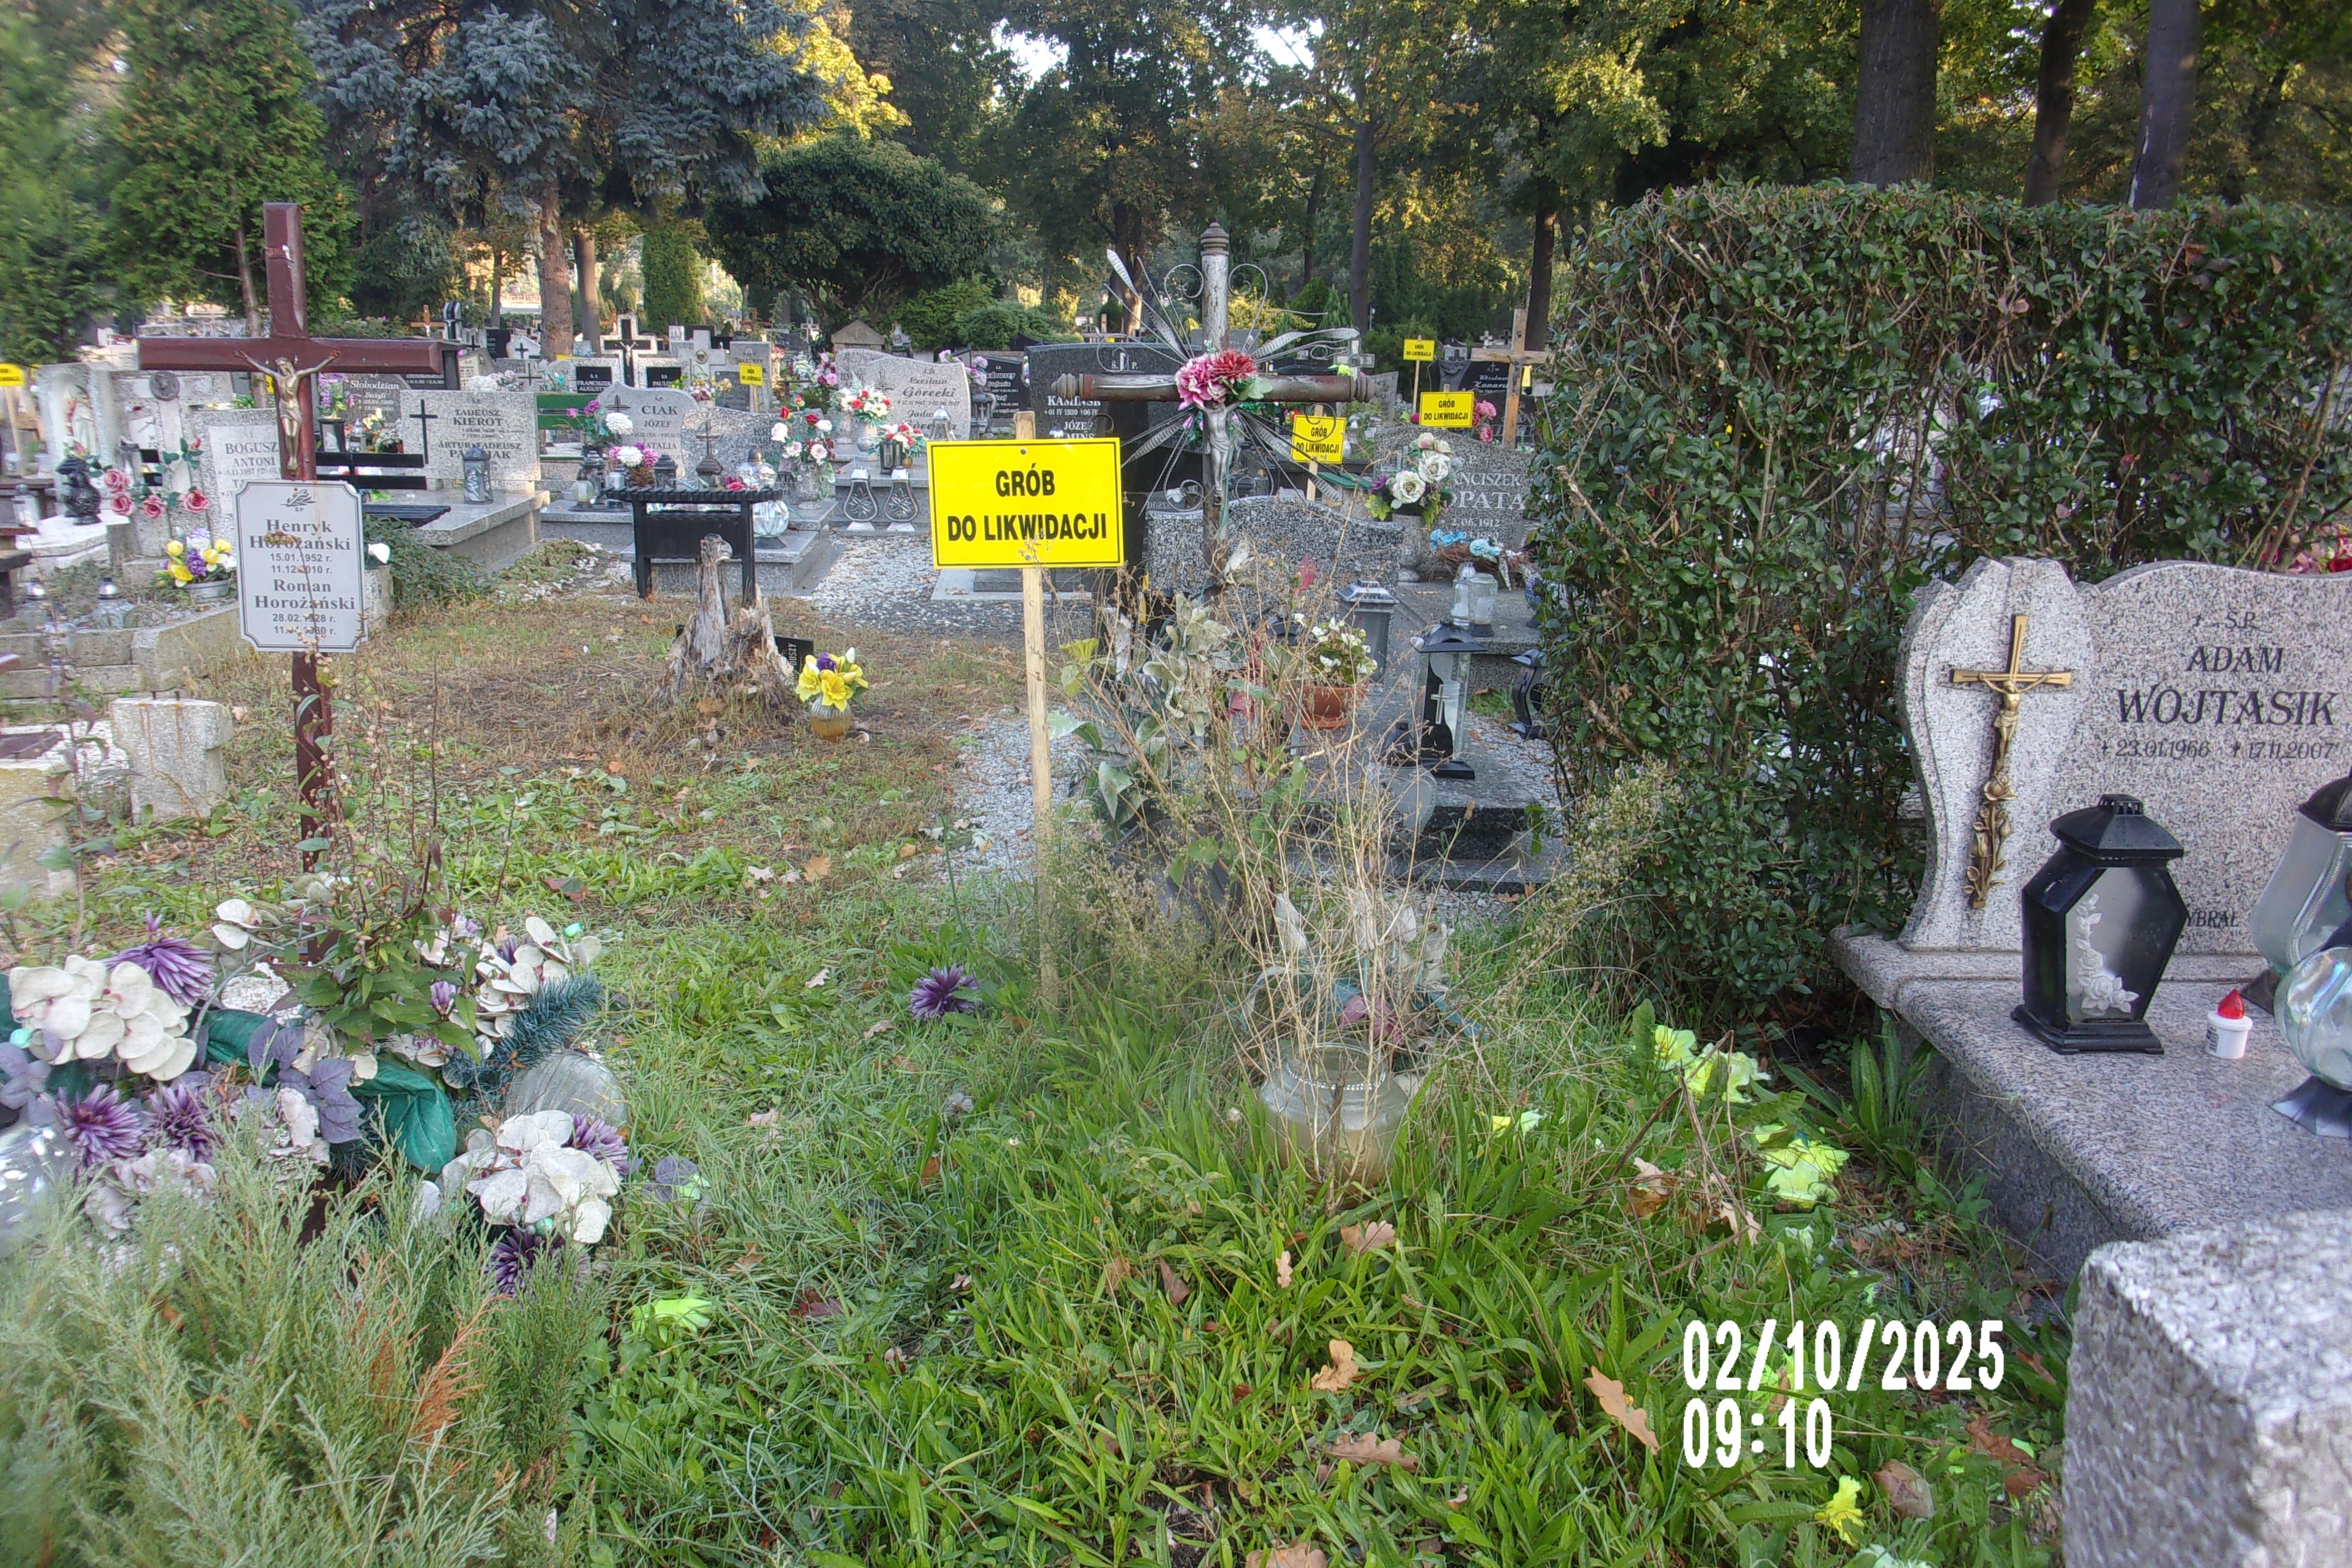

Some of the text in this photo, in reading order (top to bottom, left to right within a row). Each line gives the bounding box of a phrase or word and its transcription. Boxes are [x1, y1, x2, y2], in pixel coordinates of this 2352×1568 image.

[641, 405, 678, 415] CIAK
[1438, 398, 1455, 408] GRÓB
[453, 417, 503, 426] KIEROT
[643, 419, 672, 428] JÓZEF
[1311, 424, 1328, 437] GRÓB
[1305, 442, 1339, 454] LIKWIDACJI
[996, 462, 1056, 497] GRÓB
[265, 519, 333, 536] Henryk
[947, 512, 1107, 542] DO LIKWIDACJI
[273, 579, 331, 592] Roman
[254, 595, 356, 610] Horożański
[2184, 646, 2286, 673] ADAM
[2115, 682, 2340, 725] WOJTASIK
[2115, 740, 2211, 759] 23.01.1966
